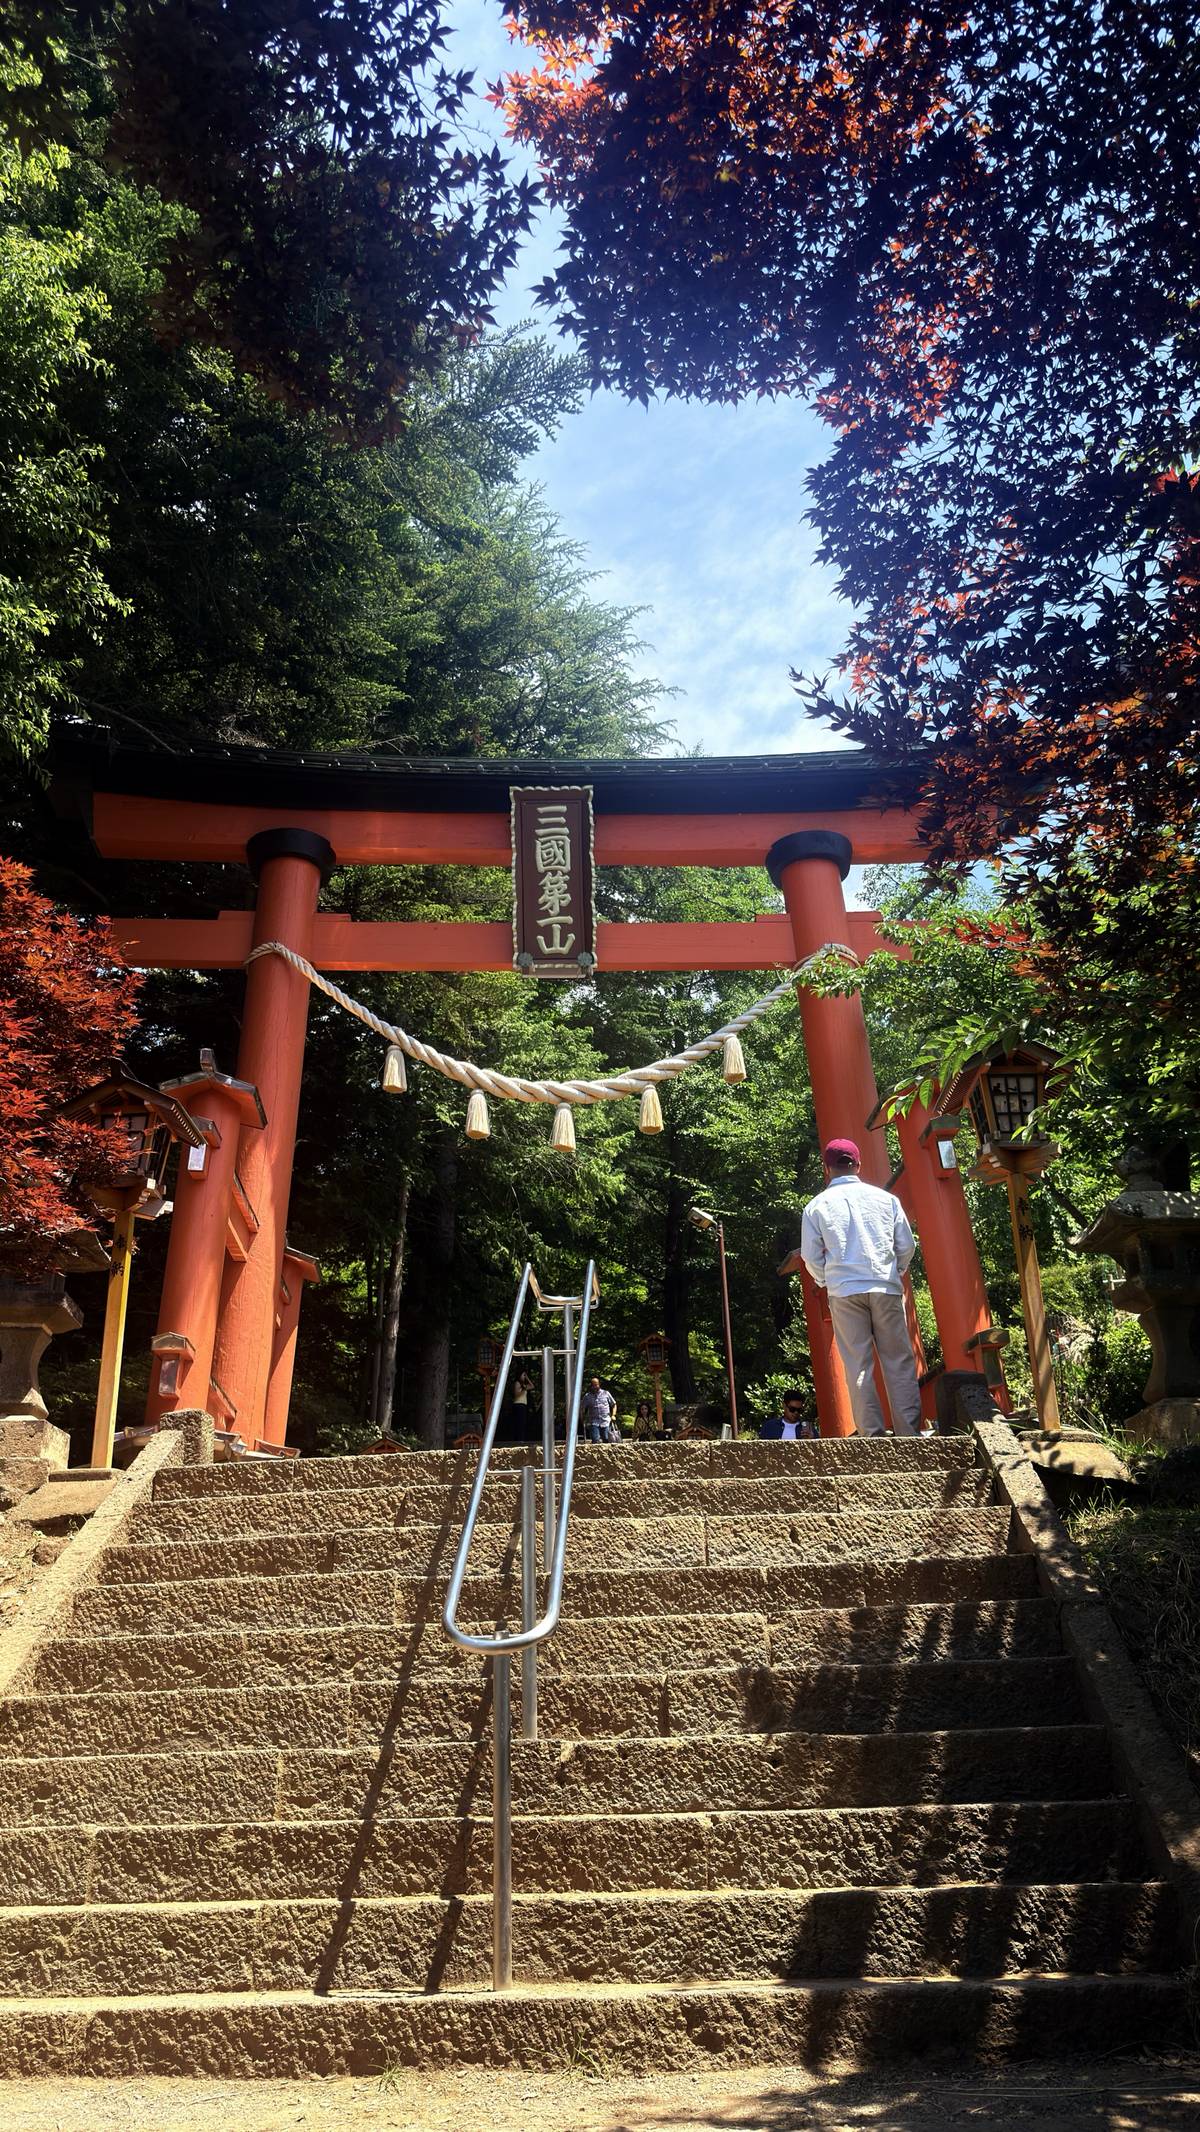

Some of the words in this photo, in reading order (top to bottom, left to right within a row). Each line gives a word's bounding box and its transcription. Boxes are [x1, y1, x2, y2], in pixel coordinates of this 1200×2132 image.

[535, 805, 576, 955] 三國第一山
